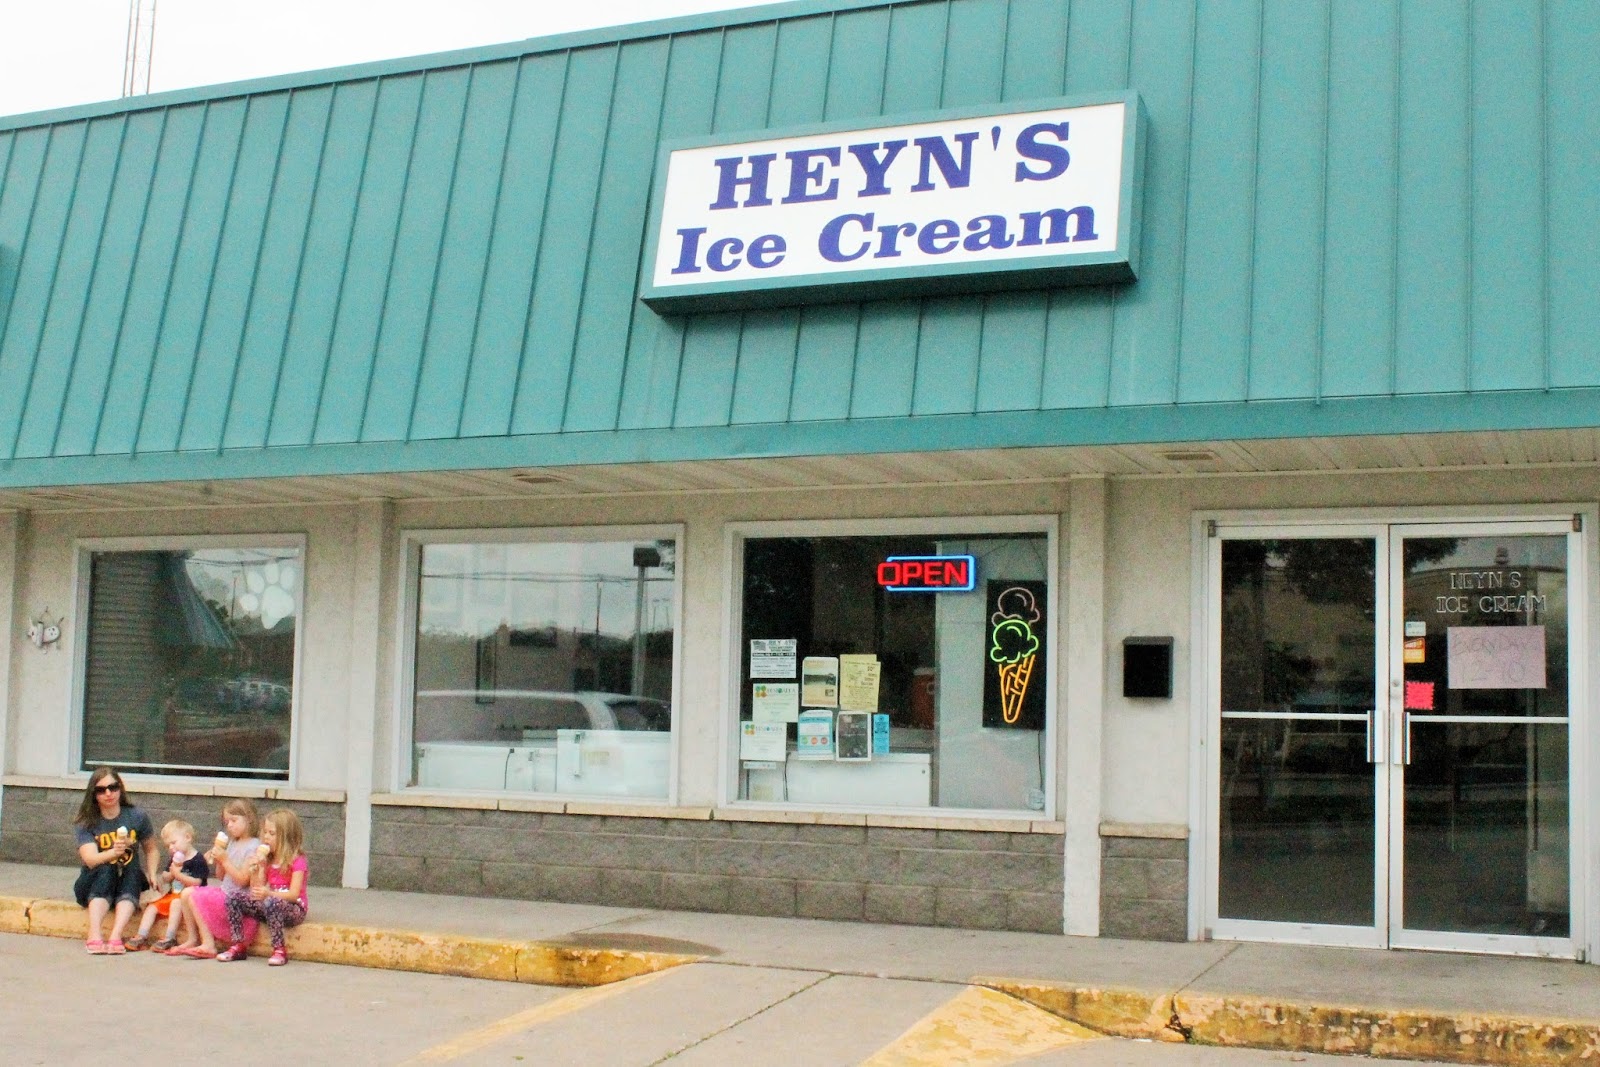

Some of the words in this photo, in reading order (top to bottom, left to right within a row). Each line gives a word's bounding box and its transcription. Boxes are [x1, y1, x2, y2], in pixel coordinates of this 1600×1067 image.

[709, 121, 1071, 210] HEYN'S
[671, 227, 787, 275] Ice
[818, 205, 1099, 263] Cream
[877, 562, 968, 586] OPEN
[1450, 571, 1521, 590] HEYNS
[1436, 596, 1469, 613] ICE
[1479, 594, 1547, 613] CREAM
